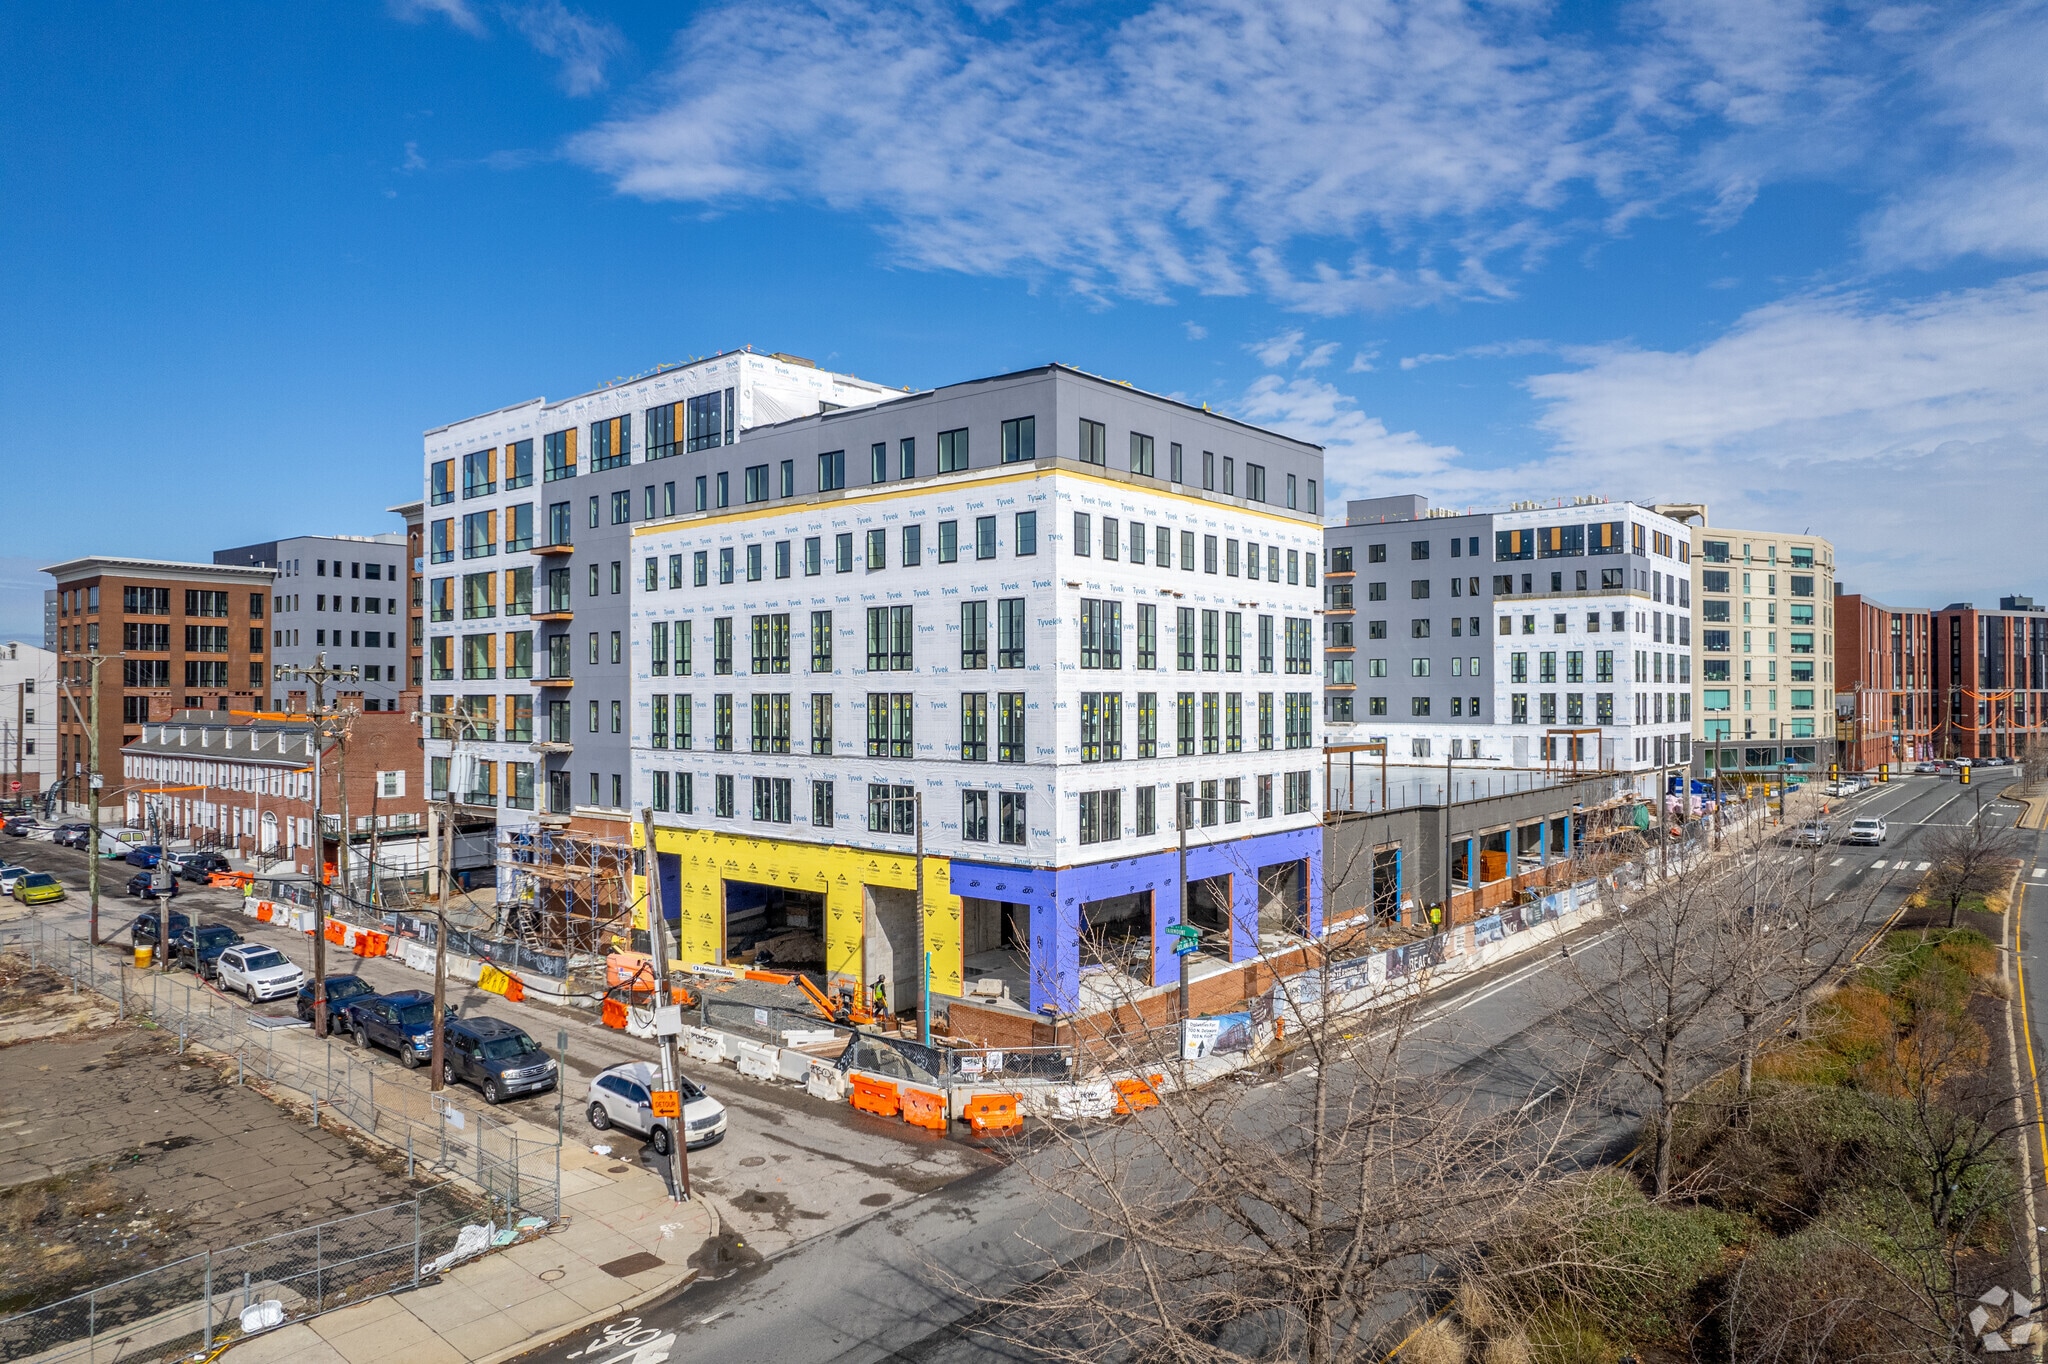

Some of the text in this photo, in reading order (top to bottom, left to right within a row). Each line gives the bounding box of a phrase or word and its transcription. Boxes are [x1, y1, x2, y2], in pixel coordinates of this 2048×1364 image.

[1055, 490, 1070, 500] Tyvek
[996, 497, 1014, 506] Tyvek
[1081, 495, 1095, 505] Tyvek
[1097, 498, 1112, 507] Tyvek
[937, 505, 954, 514] Tyvek
[966, 501, 984, 510] Tyvek
[1121, 503, 1134, 512] Tyvek
[909, 509, 926, 517] Tyvek
[1144, 508, 1157, 516] Tyvek
[1165, 512, 1177, 520] Tyvek
[856, 517, 872, 525] Tyvek
[882, 513, 898, 521] Tyvek
[832, 520, 847, 528] Tyvek
[762, 529, 776, 537] Tyvek
[959, 543, 973, 552] yvek
[823, 558, 834, 566] Tyve
[735, 567, 745, 575] yvek
[1001, 582, 1019, 591] Tyvek
[1032, 579, 1052, 589] Tyvek
[1086, 581, 1100, 589] Tyvek
[941, 587, 959, 595] Tyvek
[970, 584, 988, 593] Tyvek
[1133, 586, 1146, 595] Tyvek
[860, 593, 876, 601] Tyvek
[913, 589, 930, 598] Tyvek
[788, 599, 801, 607] Tyvek
[811, 597, 825, 605] Tyvek
[835, 595, 850, 603] Tyvek
[1037, 618, 1056, 627] Tyvek
[918, 625, 934, 633] Tyvek
[932, 666, 948, 674] Tyvek
[1060, 662, 1075, 670] Tyvek
[1036, 746, 1055, 755] Tyvek
[1065, 745, 1080, 754] Tyvek
[823, 772, 837, 780] Tyvek
[926, 779, 943, 787] Tyvek
[955, 780, 972, 789] Tyvek
[984, 781, 1002, 789] Tyvek
[835, 812, 849, 820] Tyvek
[941, 821, 958, 829] Tyvek
[1031, 828, 1050, 838] Tyvek
[1125, 827, 1135, 835] Tyve
[700, 966, 733, 976] United Rentals
